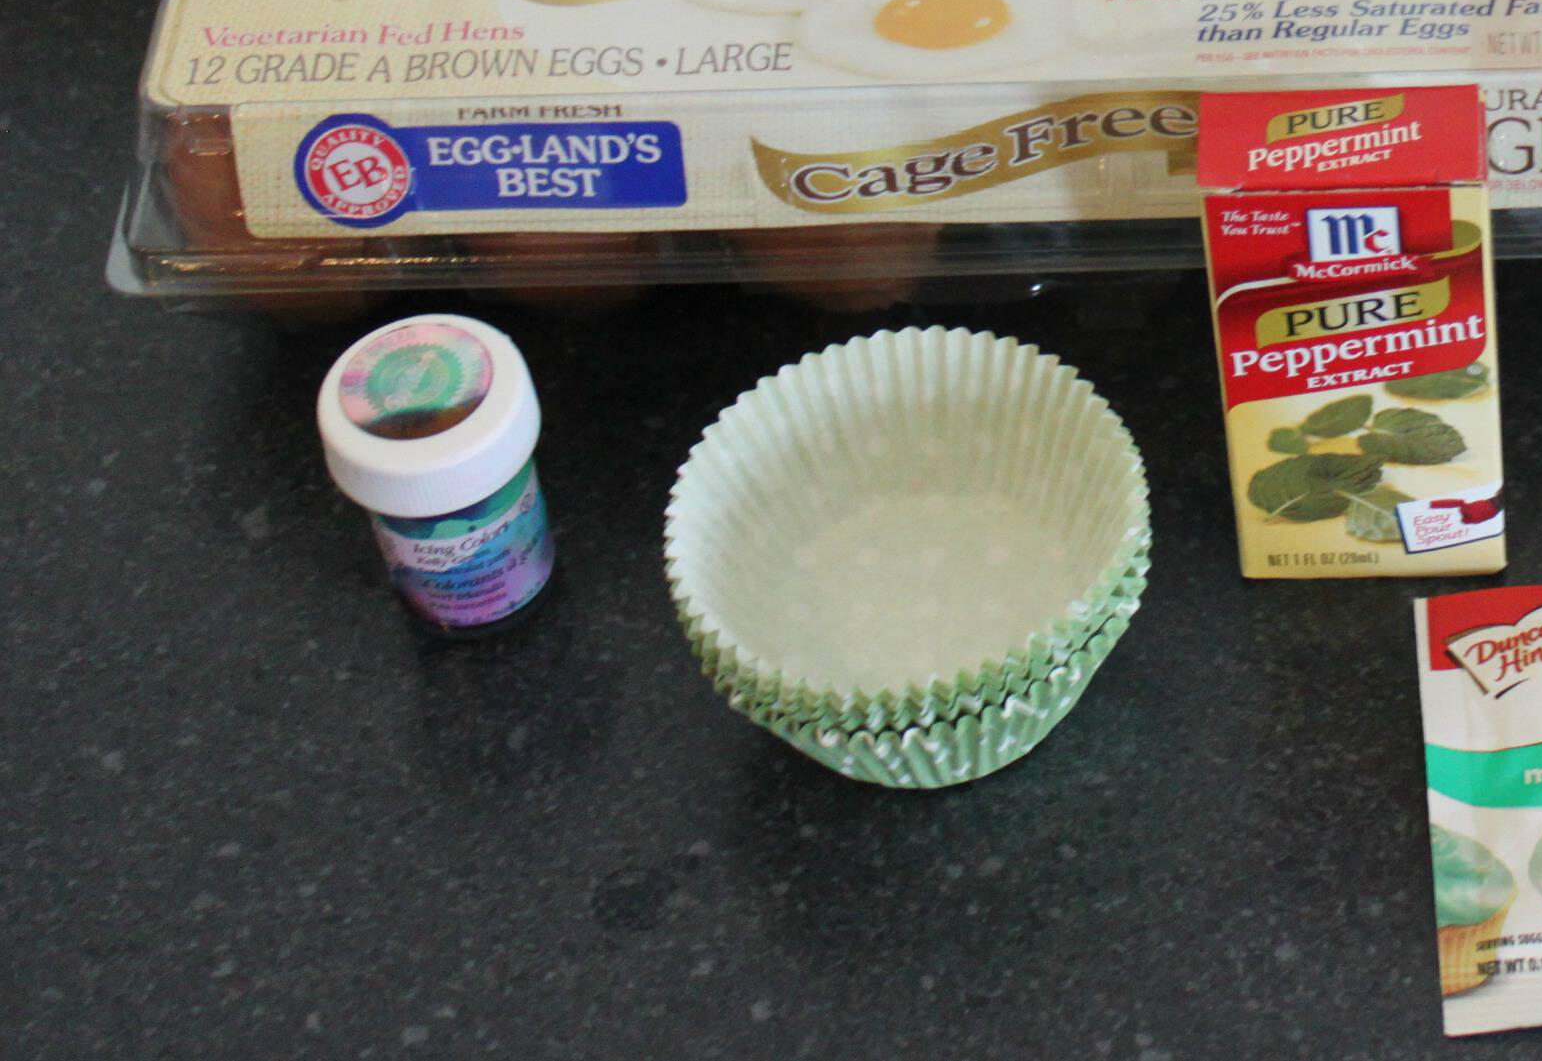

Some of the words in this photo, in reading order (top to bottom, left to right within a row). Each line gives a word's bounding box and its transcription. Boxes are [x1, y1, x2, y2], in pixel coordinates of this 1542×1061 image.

[1197, 3, 1265, 23] 25%
[1272, 0, 1340, 19] Less
[200, 21, 370, 52] Vegetarian
[376, 21, 434, 48] Fed
[441, 19, 526, 45] Hens
[1196, 23, 1263, 43] than
[1271, 19, 1391, 43] Regular
[1400, 17, 1473, 41] Eggs
[184, 56, 227, 88] 12
[233, 51, 359, 87] GRADE
[364, 49, 399, 83] A
[403, 46, 539, 83] BROWN
[547, 45, 646, 78] EGGS
[675, 41, 795, 76] LARGE
[1285, 100, 1386, 135] PURE
[310, 127, 386, 172] QUALITY
[792, 142, 999, 203] Cage
[1008, 104, 1199, 165] Free
[1246, 119, 1423, 173] Peppermint
[1316, 149, 1393, 173] EXTRACT
[327, 154, 390, 193] EB
[496, 166, 603, 199] BEST
[1220, 223, 1245, 237] You
[1221, 210, 1248, 223] The
[1251, 209, 1290, 223] Taste
[1293, 257, 1416, 280] McCormick
[1282, 289, 1424, 339] PURE
[1230, 313, 1485, 379] Peppermint
[1305, 360, 1415, 391] EXTRACT
[1412, 513, 1451, 530] Easy
[1415, 523, 1453, 537] Pour
[1266, 554, 1291, 568] NET
[1504, 957, 1526, 974] WT
